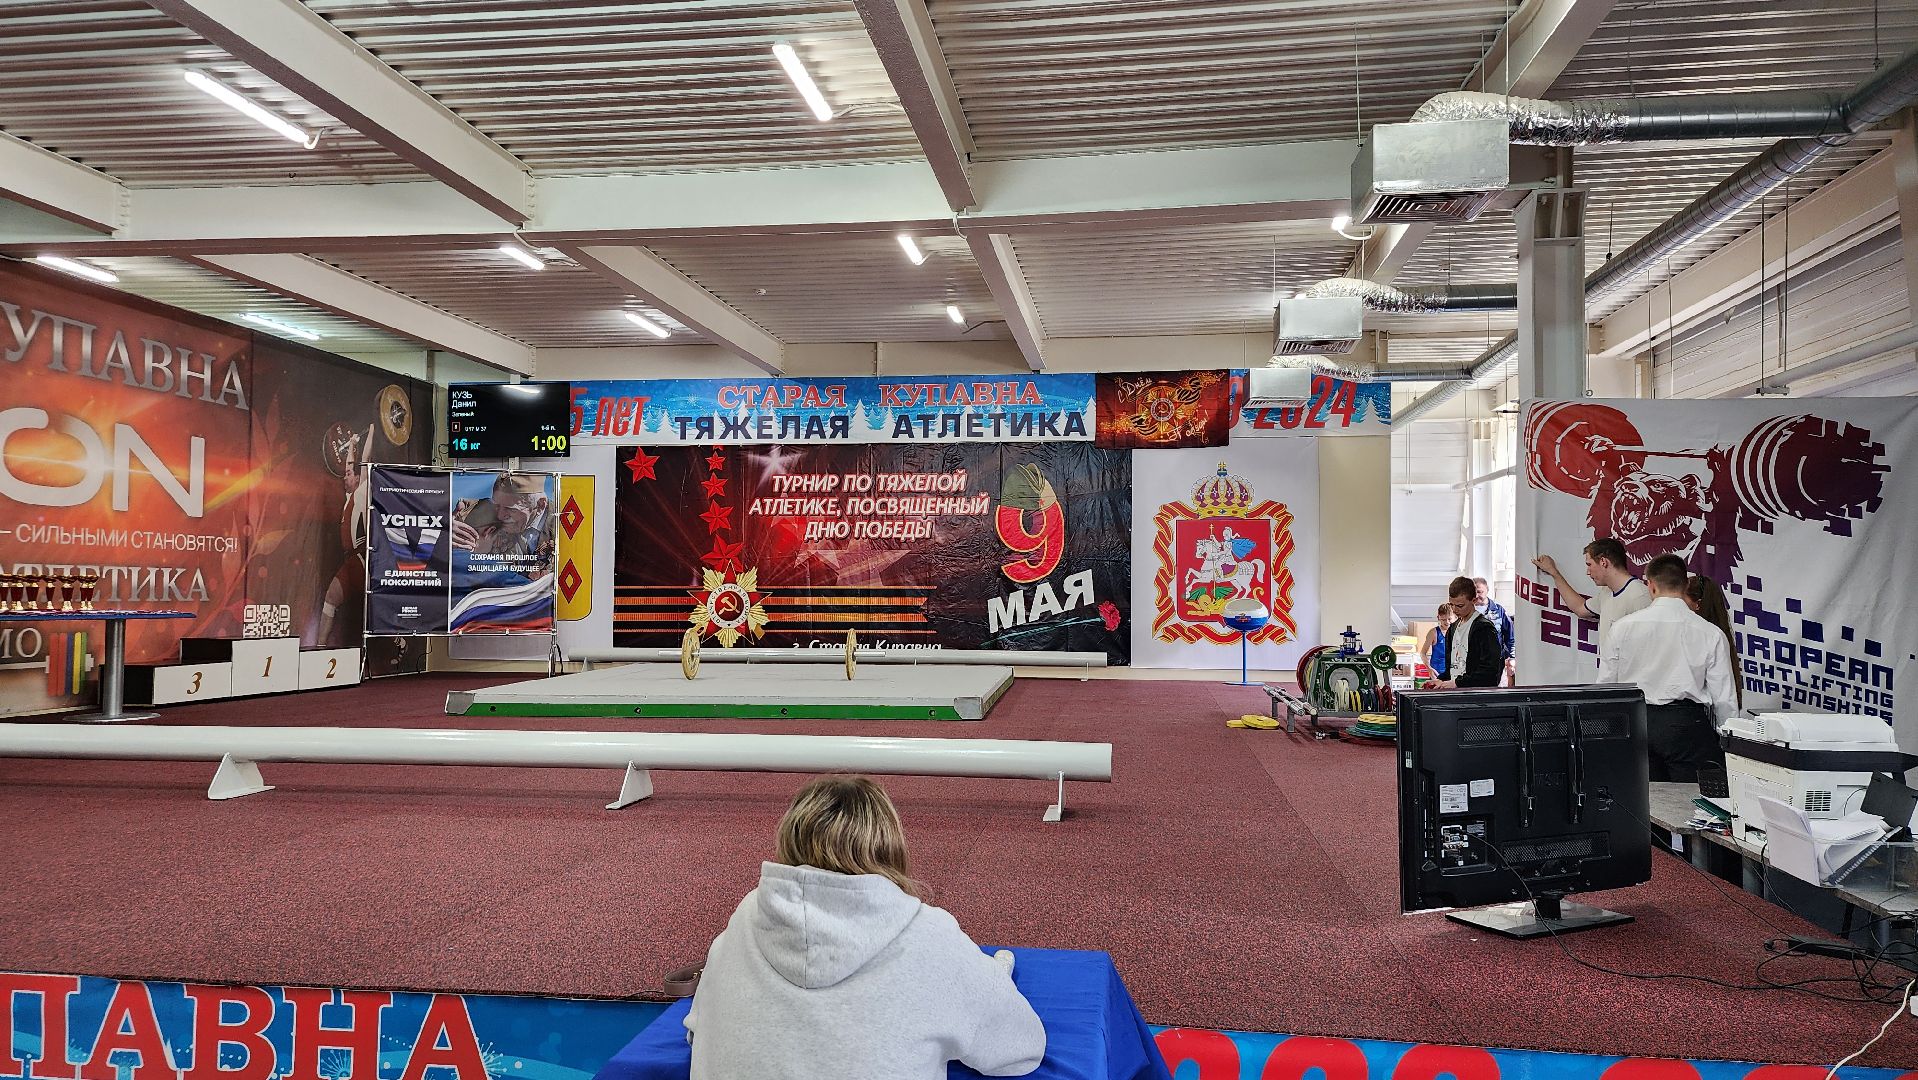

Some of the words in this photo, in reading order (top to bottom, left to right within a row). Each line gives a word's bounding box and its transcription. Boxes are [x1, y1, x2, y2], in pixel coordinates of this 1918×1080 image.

[452, 390, 473, 399] КУЗЬ
[452, 400, 477, 409] Данил
[718, 385, 847, 409] СТАРАЯ
[878, 381, 1043, 407] КУПАВНА
[591, 396, 650, 437] лет
[675, 415, 849, 441] ТЯЖЕЛАЯ
[891, 411, 1087, 439] АТЛЕТИКА
[452, 438, 468, 451] 16
[470, 442, 481, 450] кг
[531, 435, 567, 451] 1:00
[772, 474, 839, 493] ТУРНИР
[842, 474, 872, 493] ПО
[877, 468, 968, 493] ТЯЖЕЛОЙ
[749, 498, 842, 517] АТЛЕТИКЕ,
[846, 492, 990, 519] ПОСВЯЩЕННЫЙ
[380, 513, 443, 528] УСПЕХ
[804, 520, 850, 541] ДНЮ
[853, 520, 934, 541] ПОБЕДЫ
[15, 523, 128, 548] СИЛЬНЫМИ
[131, 530, 238, 553] СТАНОВЯТСЯ!
[995, 500, 1064, 584] 9
[467, 564, 509, 573] ЗАЩИЩАЕМ
[510, 564, 540, 573] БУДУЩЕЕ
[470, 553, 504, 561] СОХРАНЯЯ
[0, 563, 210, 603] ТЛЕТИКА
[380, 577, 442, 587] ПОКОЛЕНИЙ
[384, 569, 438, 578] ЕДИНСТВЕ
[987, 568, 1095, 634] МАЯ
[262, 655, 273, 678] 1
[325, 657, 337, 679] 2
[1735, 631, 1894, 691] ROPEAN
[186, 671, 203, 695] 3
[1739, 658, 1893, 709] GHTLIFTING
[1741, 675, 1893, 727] MPIONSHIPS
